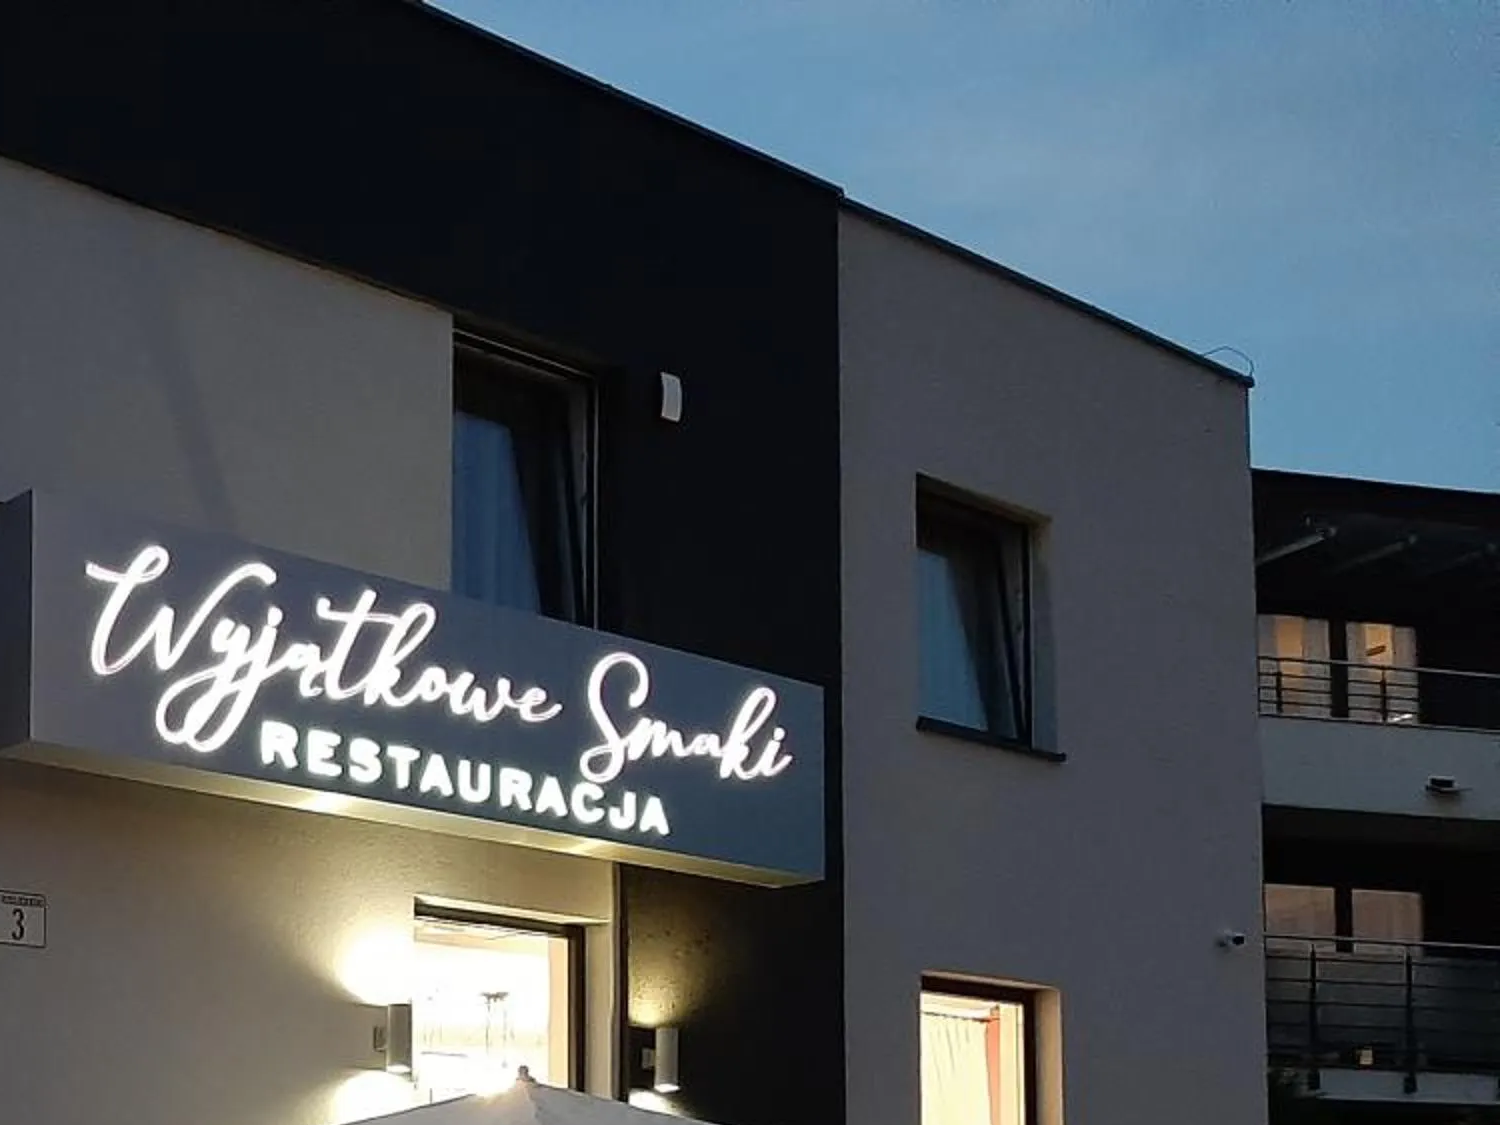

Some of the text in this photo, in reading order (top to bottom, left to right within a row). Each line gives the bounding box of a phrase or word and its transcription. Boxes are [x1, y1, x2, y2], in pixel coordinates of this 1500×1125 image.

[84, 544, 794, 784] Wyjątkowe Smaki
[258, 719, 671, 836] RESTAURACJA
[11, 907, 25, 941] 3
